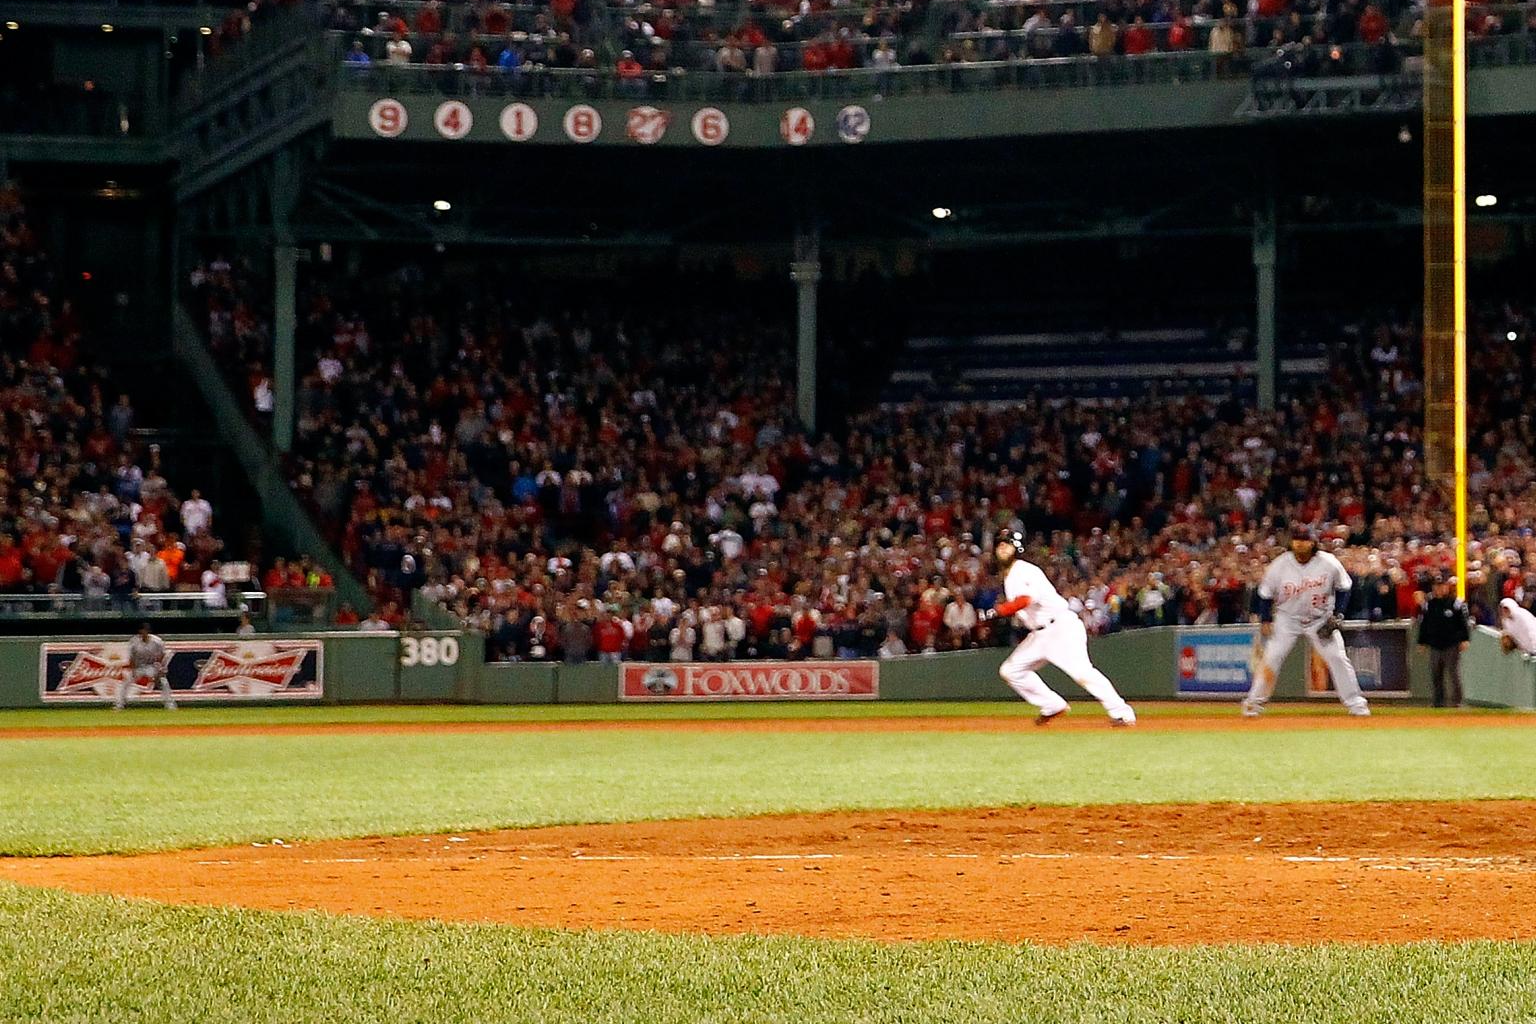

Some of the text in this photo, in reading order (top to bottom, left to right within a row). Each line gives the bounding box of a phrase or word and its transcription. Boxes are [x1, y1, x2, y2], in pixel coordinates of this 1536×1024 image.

[379, 106, 400, 132] 9
[444, 108, 462, 132] 4
[514, 110, 525, 136] 1
[573, 110, 594, 137] 8
[701, 115, 721, 139] 6
[400, 637, 459, 667] 380
[684, 668, 851, 694] FOXWOODS
